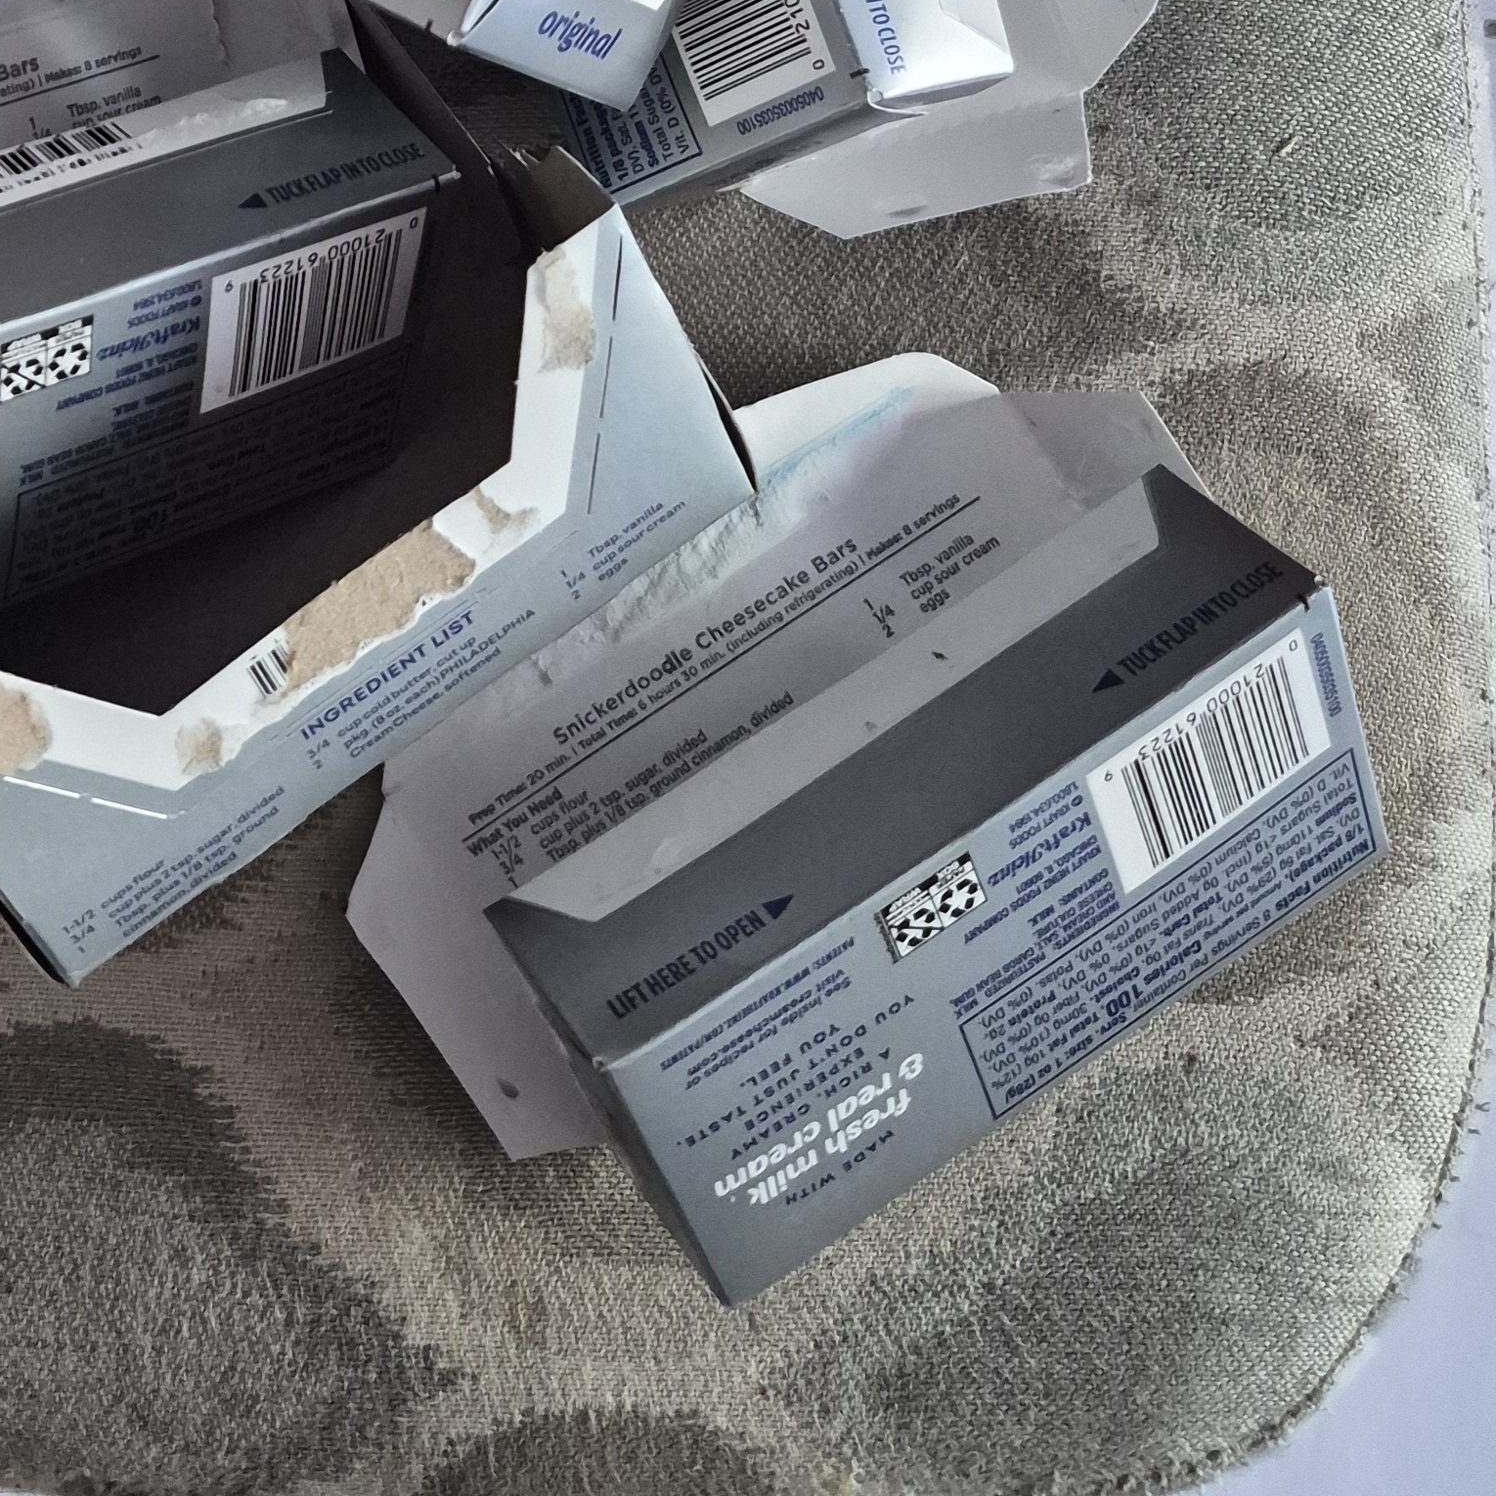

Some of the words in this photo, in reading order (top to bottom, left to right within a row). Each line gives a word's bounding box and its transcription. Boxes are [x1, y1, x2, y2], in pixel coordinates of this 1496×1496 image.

[537, 9, 623, 60] original
[876, 24, 906, 74] CLOSE
[653, 85, 676, 115] (0%
[671, 129, 691, 154] Vit.
[265, 178, 310, 204] TUCK
[303, 166, 342, 192] FLAP
[339, 161, 363, 180] IN
[355, 154, 383, 175] TO
[377, 142, 425, 168] CLOSE
[258, 250, 317, 284] 61223
[326, 227, 385, 261] 21000
[898, 562, 935, 586] Tbsp.
[933, 534, 974, 564] vanilla
[909, 580, 934, 600] cup
[933, 561, 961, 584] sour
[961, 536, 1001, 566] cream
[918, 588, 950, 613] eggs
[1116, 638, 1167, 676] TUCK
[1156, 613, 1199, 652] FLAP
[1191, 601, 1221, 627] IN
[1207, 587, 1239, 614] TO
[1229, 559, 1283, 601] CLOSE
[552, 647, 693, 745] Snickerdoodle
[694, 569, 810, 650] Cheesecake
[809, 538, 857, 574] Bars
[300, 643, 425, 740] INGREDIENT
[430, 609, 473, 648] LIST
[1204, 660, 1266, 716] 21000
[1135, 708, 1199, 763] 61223
[464, 827, 504, 857] What
[501, 811, 529, 832] You
[526, 785, 563, 816] Need
[606, 981, 651, 1021] LIFT
[642, 951, 696, 998] HERE
[688, 937, 720, 968] TO
[712, 907, 766, 953] OPEN
[874, 993, 915, 1025] YOU
[798, 1023, 841, 1055] YOU
[808, 1023, 867, 1070] DON'T
[897, 1052, 923, 1080] &
[743, 1046, 865, 1131] EXPERIENCE
[752, 1068, 800, 1107] JUST
[826, 1071, 892, 1131] real
[730, 1102, 811, 1160] CREAMY
[824, 1088, 911, 1154] fresh
[713, 1120, 821, 1197] cream
[746, 1148, 819, 1205] milk
